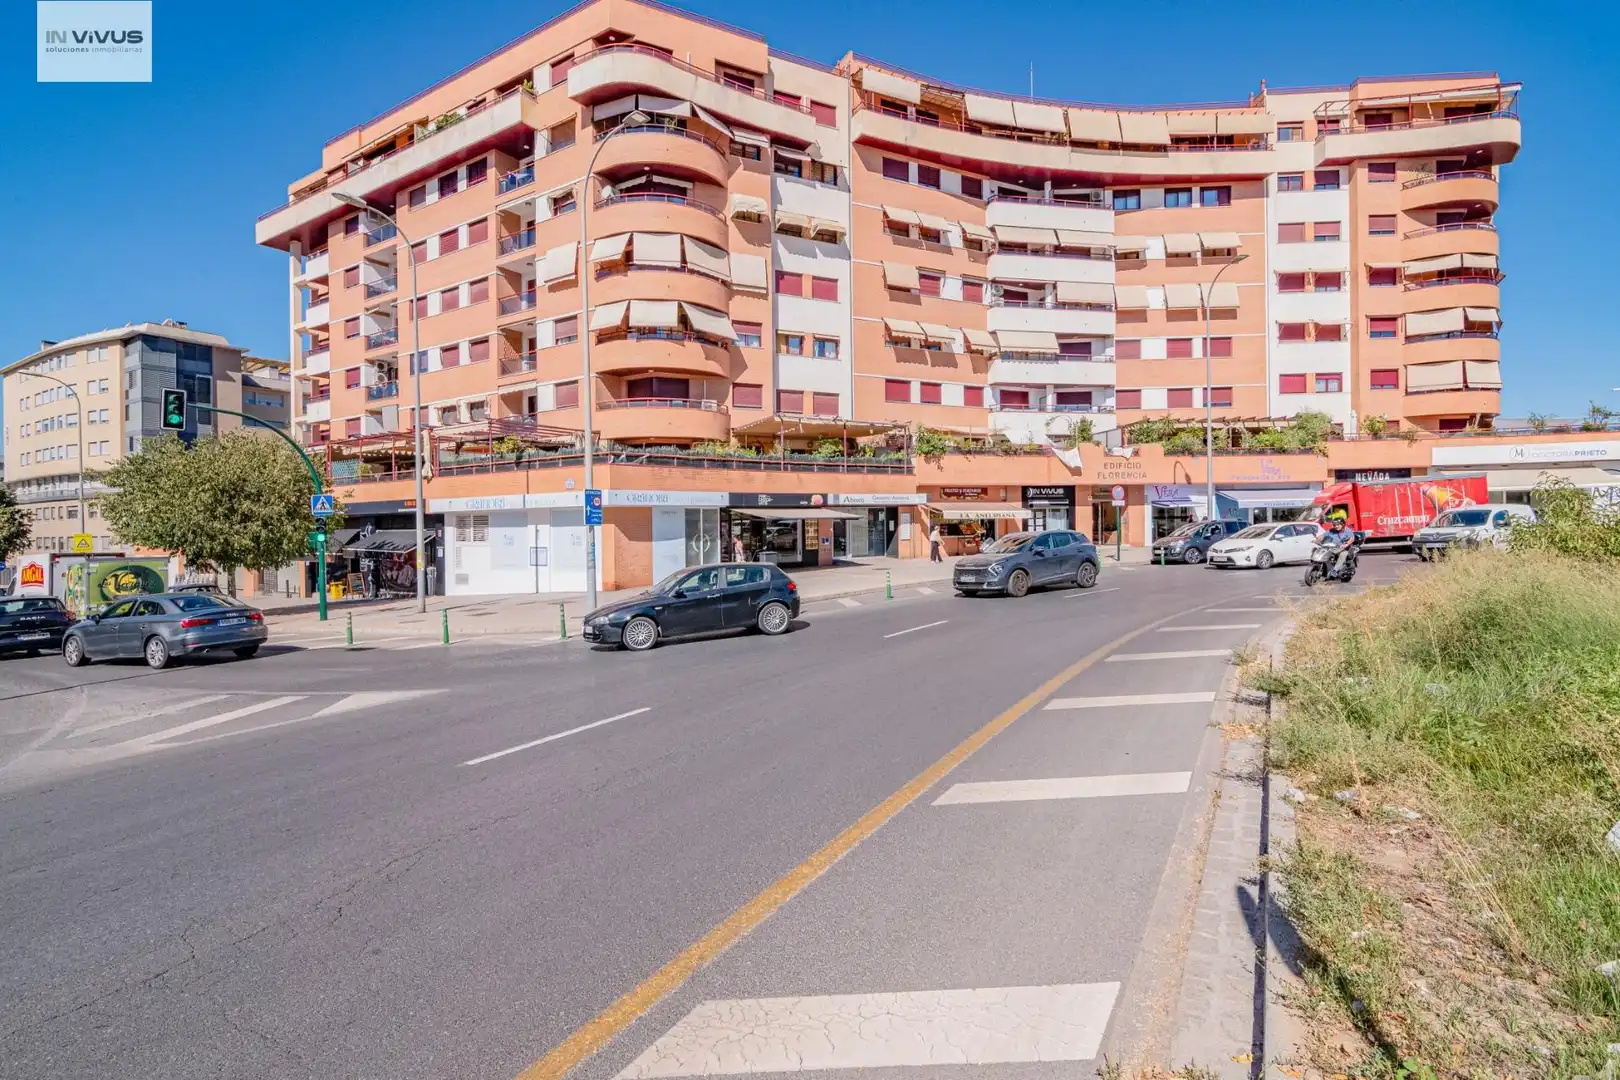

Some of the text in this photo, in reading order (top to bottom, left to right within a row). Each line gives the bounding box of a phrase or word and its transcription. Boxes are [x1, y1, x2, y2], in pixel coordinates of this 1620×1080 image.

[1103, 462, 1142, 470] EDIFICIO
[1097, 471, 1148, 480] FLORENCIA
[1355, 471, 1390, 481] NEVADA
[1377, 514, 1430, 527] Cruzcampo
